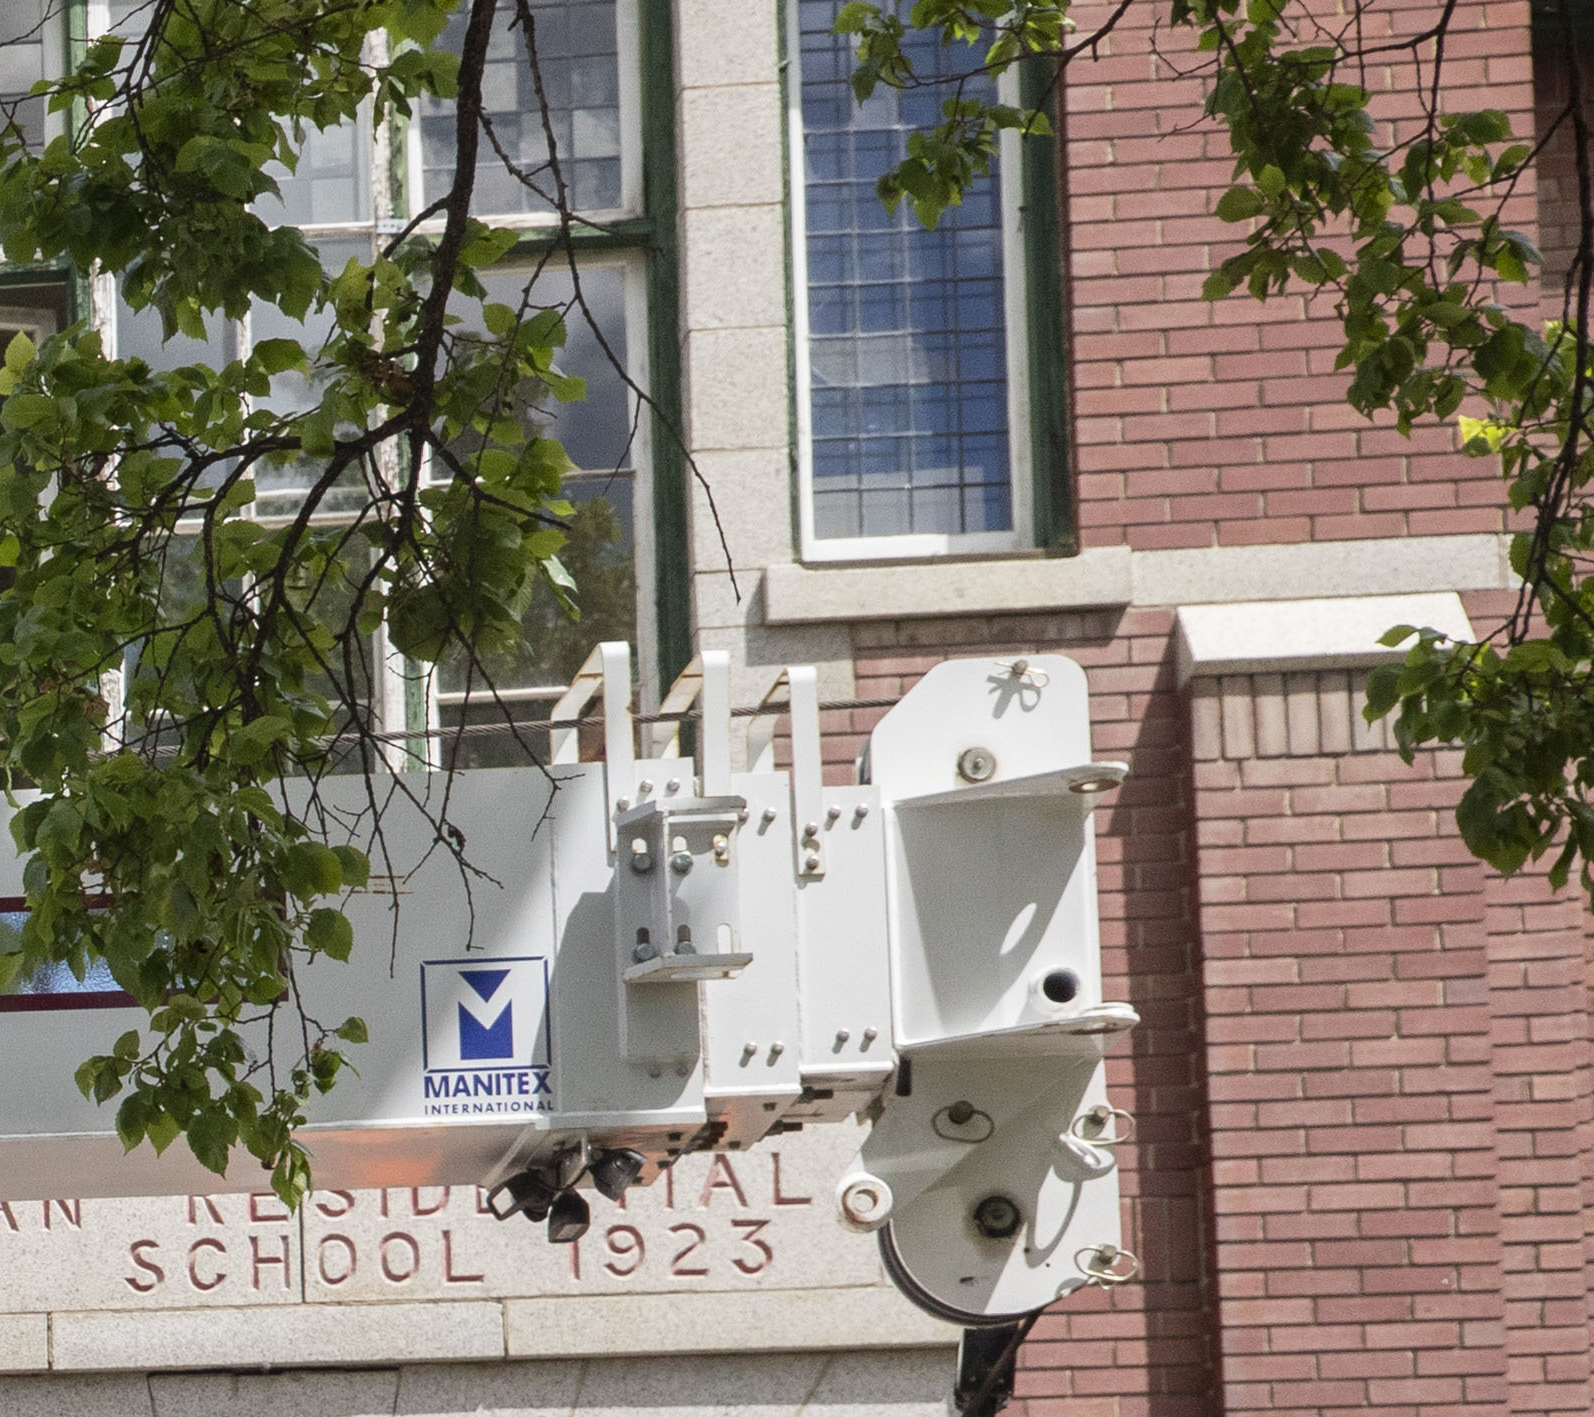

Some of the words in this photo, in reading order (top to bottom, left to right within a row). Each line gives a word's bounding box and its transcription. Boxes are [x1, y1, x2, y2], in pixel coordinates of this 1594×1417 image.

[424, 1071, 553, 1098] MANITEX
[424, 1099, 555, 1115] INTERNATIONAL
[123, 1230, 485, 1293] SCHOOL
[568, 1218, 775, 1281] 1923
